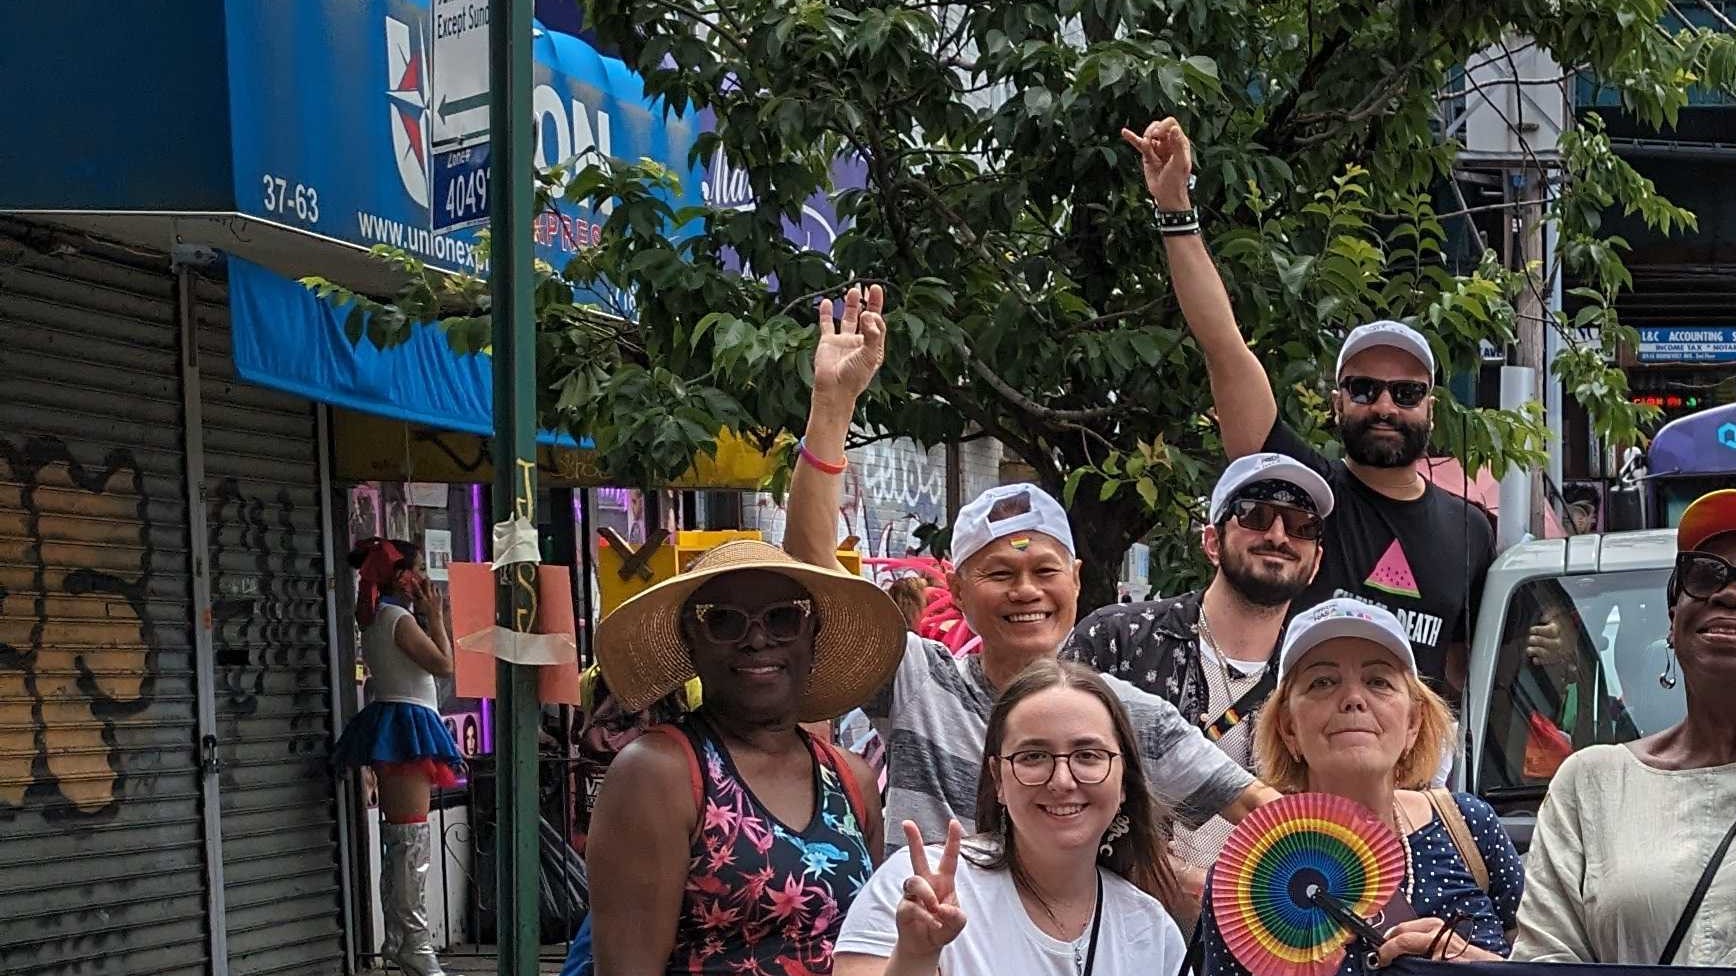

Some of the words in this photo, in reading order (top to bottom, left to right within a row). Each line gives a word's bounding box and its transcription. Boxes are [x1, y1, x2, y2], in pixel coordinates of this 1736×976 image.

[438, 6, 466, 39] Except
[262, 173, 320, 224] 37-63
[1642, 331, 1659, 342] L&C
[1669, 331, 1723, 342] ACCOUNTING
